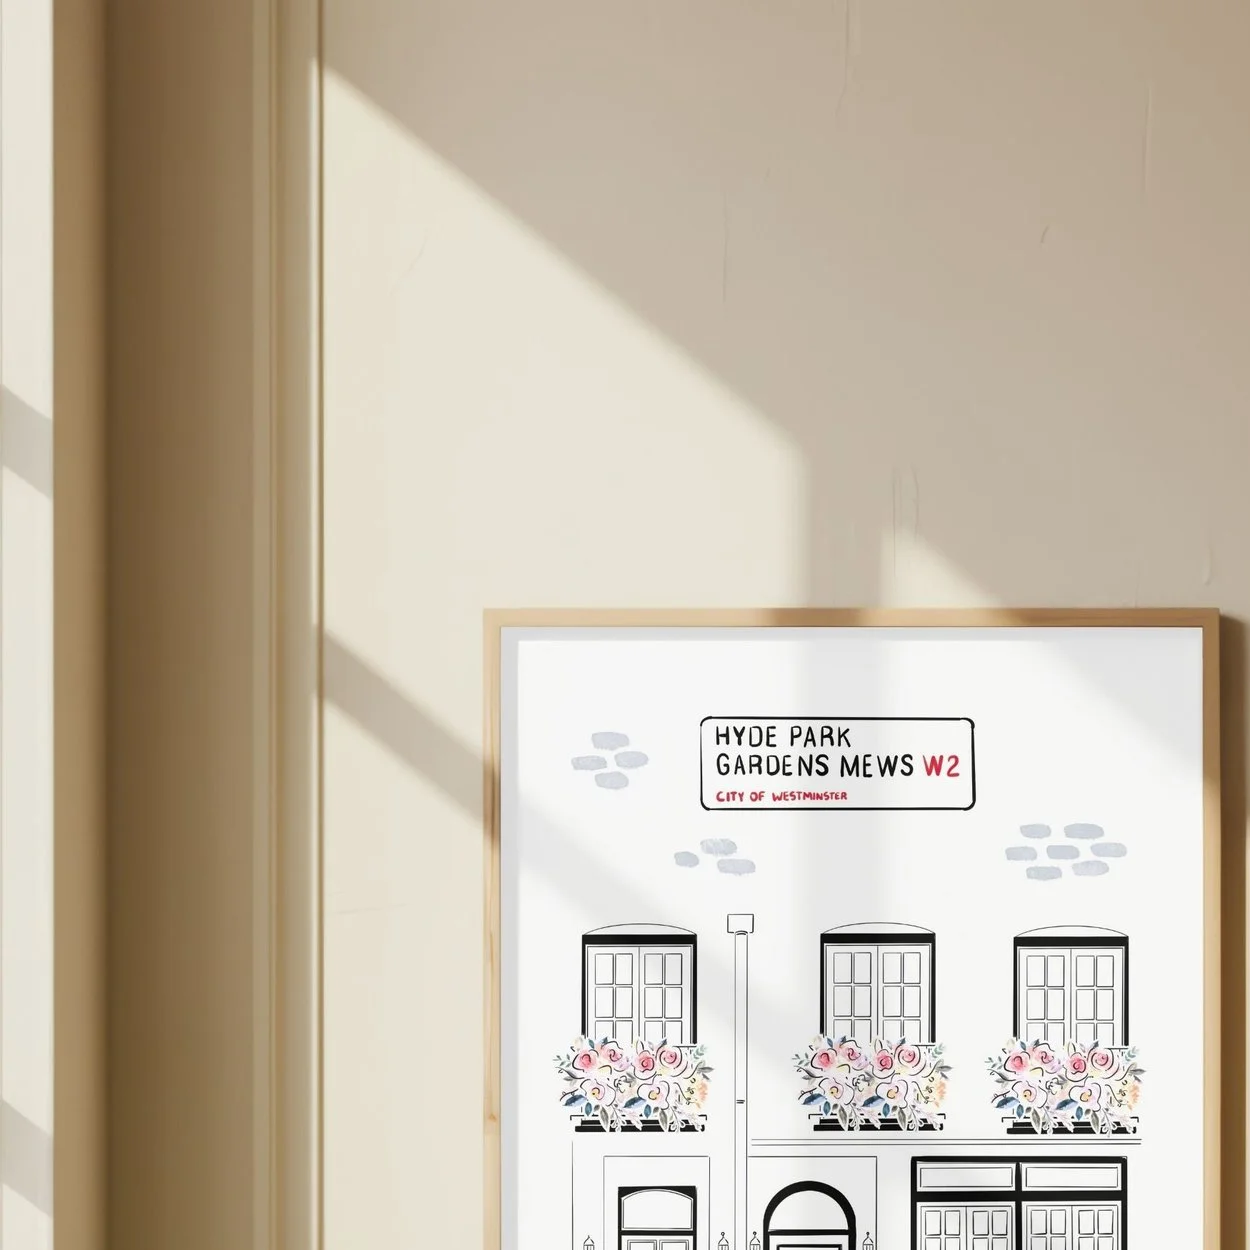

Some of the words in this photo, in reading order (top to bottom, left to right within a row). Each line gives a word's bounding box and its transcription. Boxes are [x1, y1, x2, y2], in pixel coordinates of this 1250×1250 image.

[715, 725, 777, 748] HYDE
[790, 725, 852, 748] PARK
[716, 753, 830, 777] GARDENS
[840, 753, 914, 778] MEWS
[922, 754, 960, 778] W2
[716, 791, 745, 802] CITY
[749, 791, 766, 802] OF
[772, 790, 848, 802] WESTMINSTER
